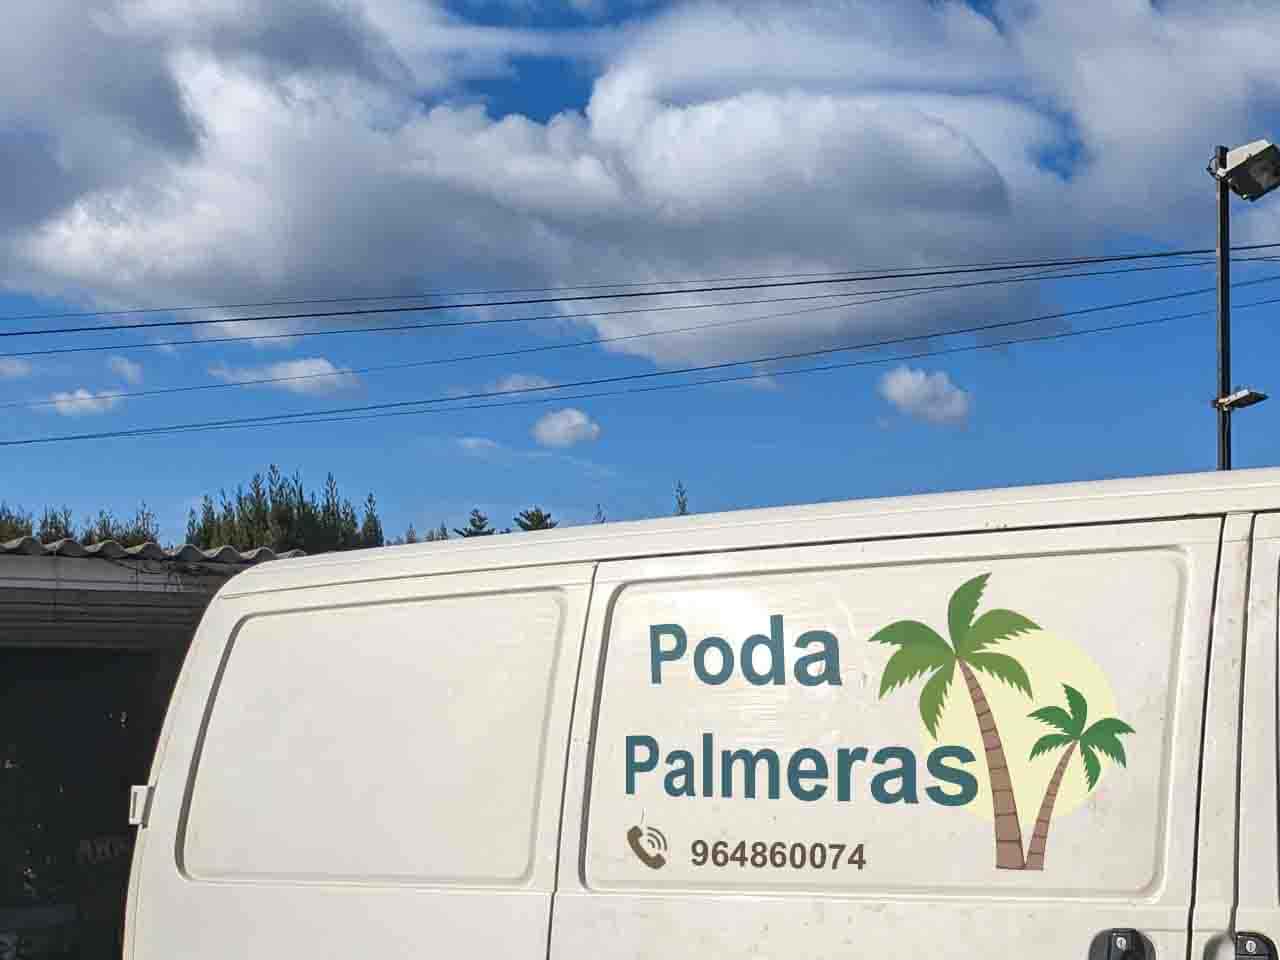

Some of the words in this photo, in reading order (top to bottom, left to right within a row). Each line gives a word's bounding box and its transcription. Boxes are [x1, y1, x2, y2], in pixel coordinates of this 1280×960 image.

[649, 614, 842, 686] Poda
[625, 733, 979, 806] Palmeras
[691, 838, 867, 870] 964860074
